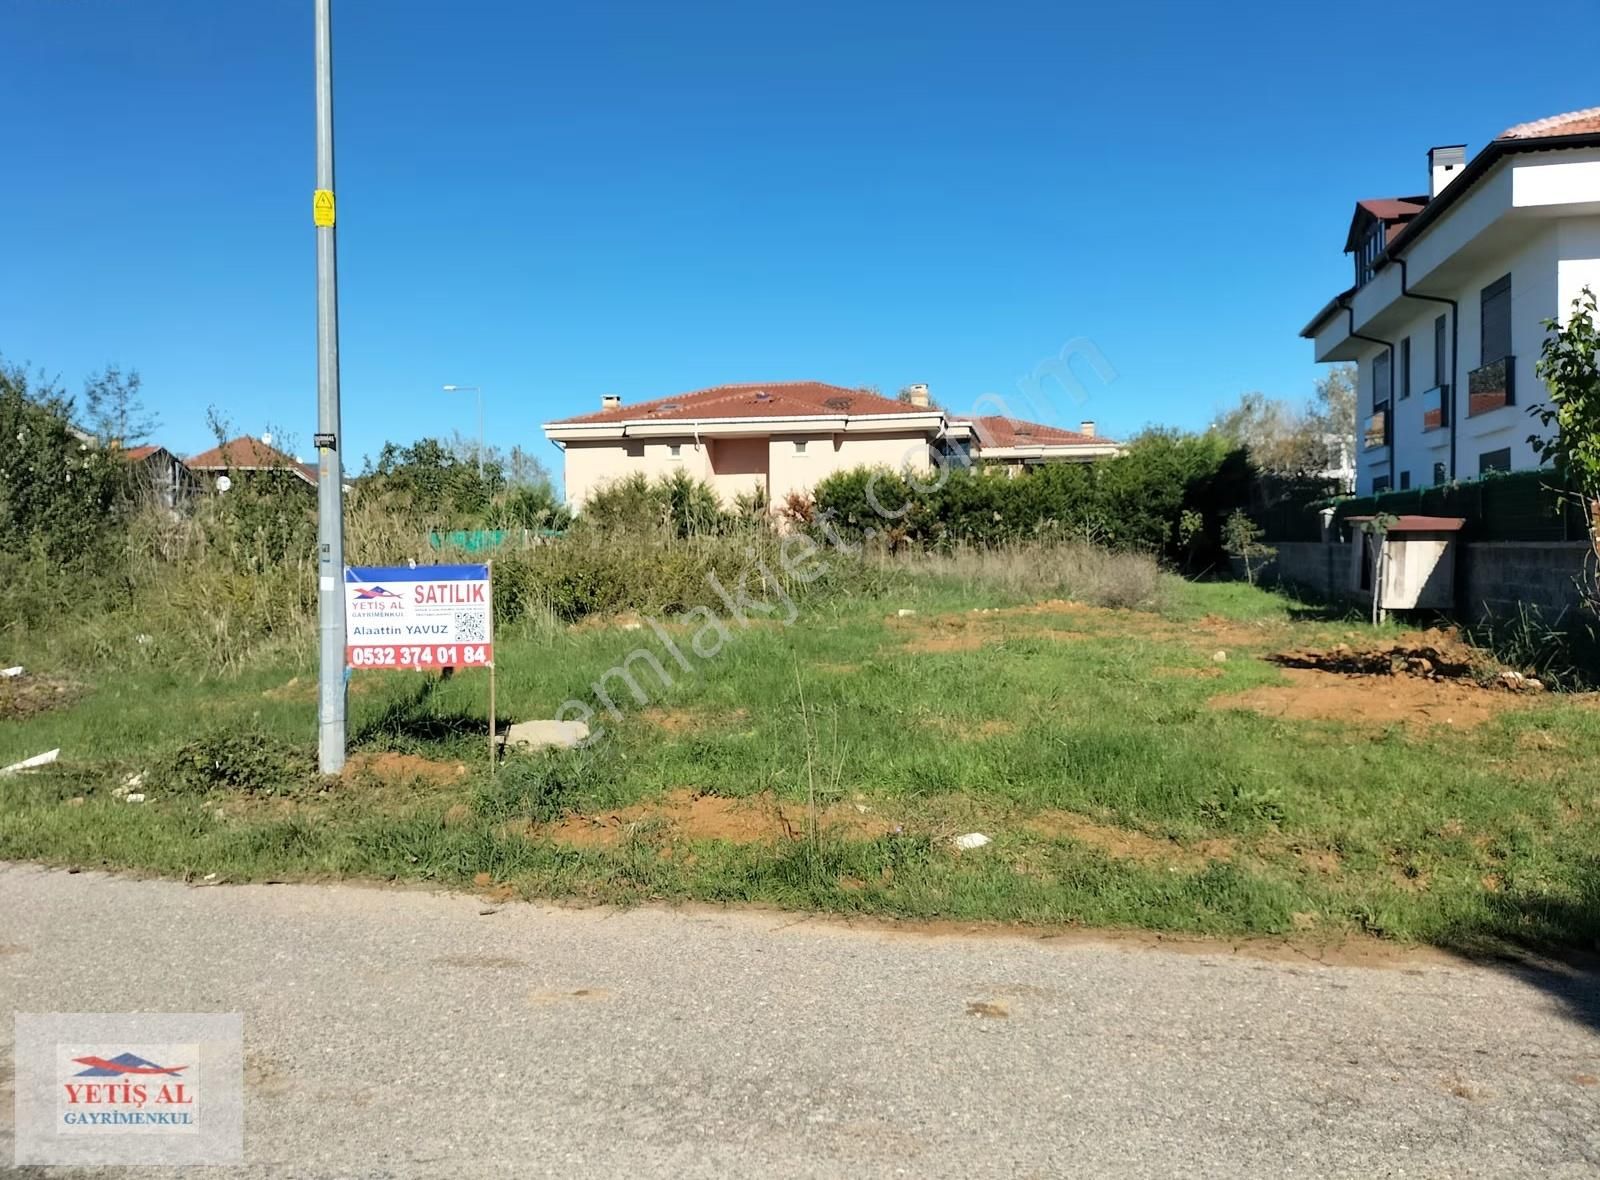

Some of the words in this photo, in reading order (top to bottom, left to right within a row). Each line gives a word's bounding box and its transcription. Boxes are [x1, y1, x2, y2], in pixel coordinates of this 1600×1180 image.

[414, 583, 485, 604] SATILIK
[390, 601, 405, 610] AL
[353, 625, 401, 635] Alaattin
[406, 625, 448, 635] YAVUZ
[352, 647, 396, 665] 0532
[400, 646, 433, 665] 374
[436, 646, 457, 663] 01
[463, 645, 486, 663] 84
